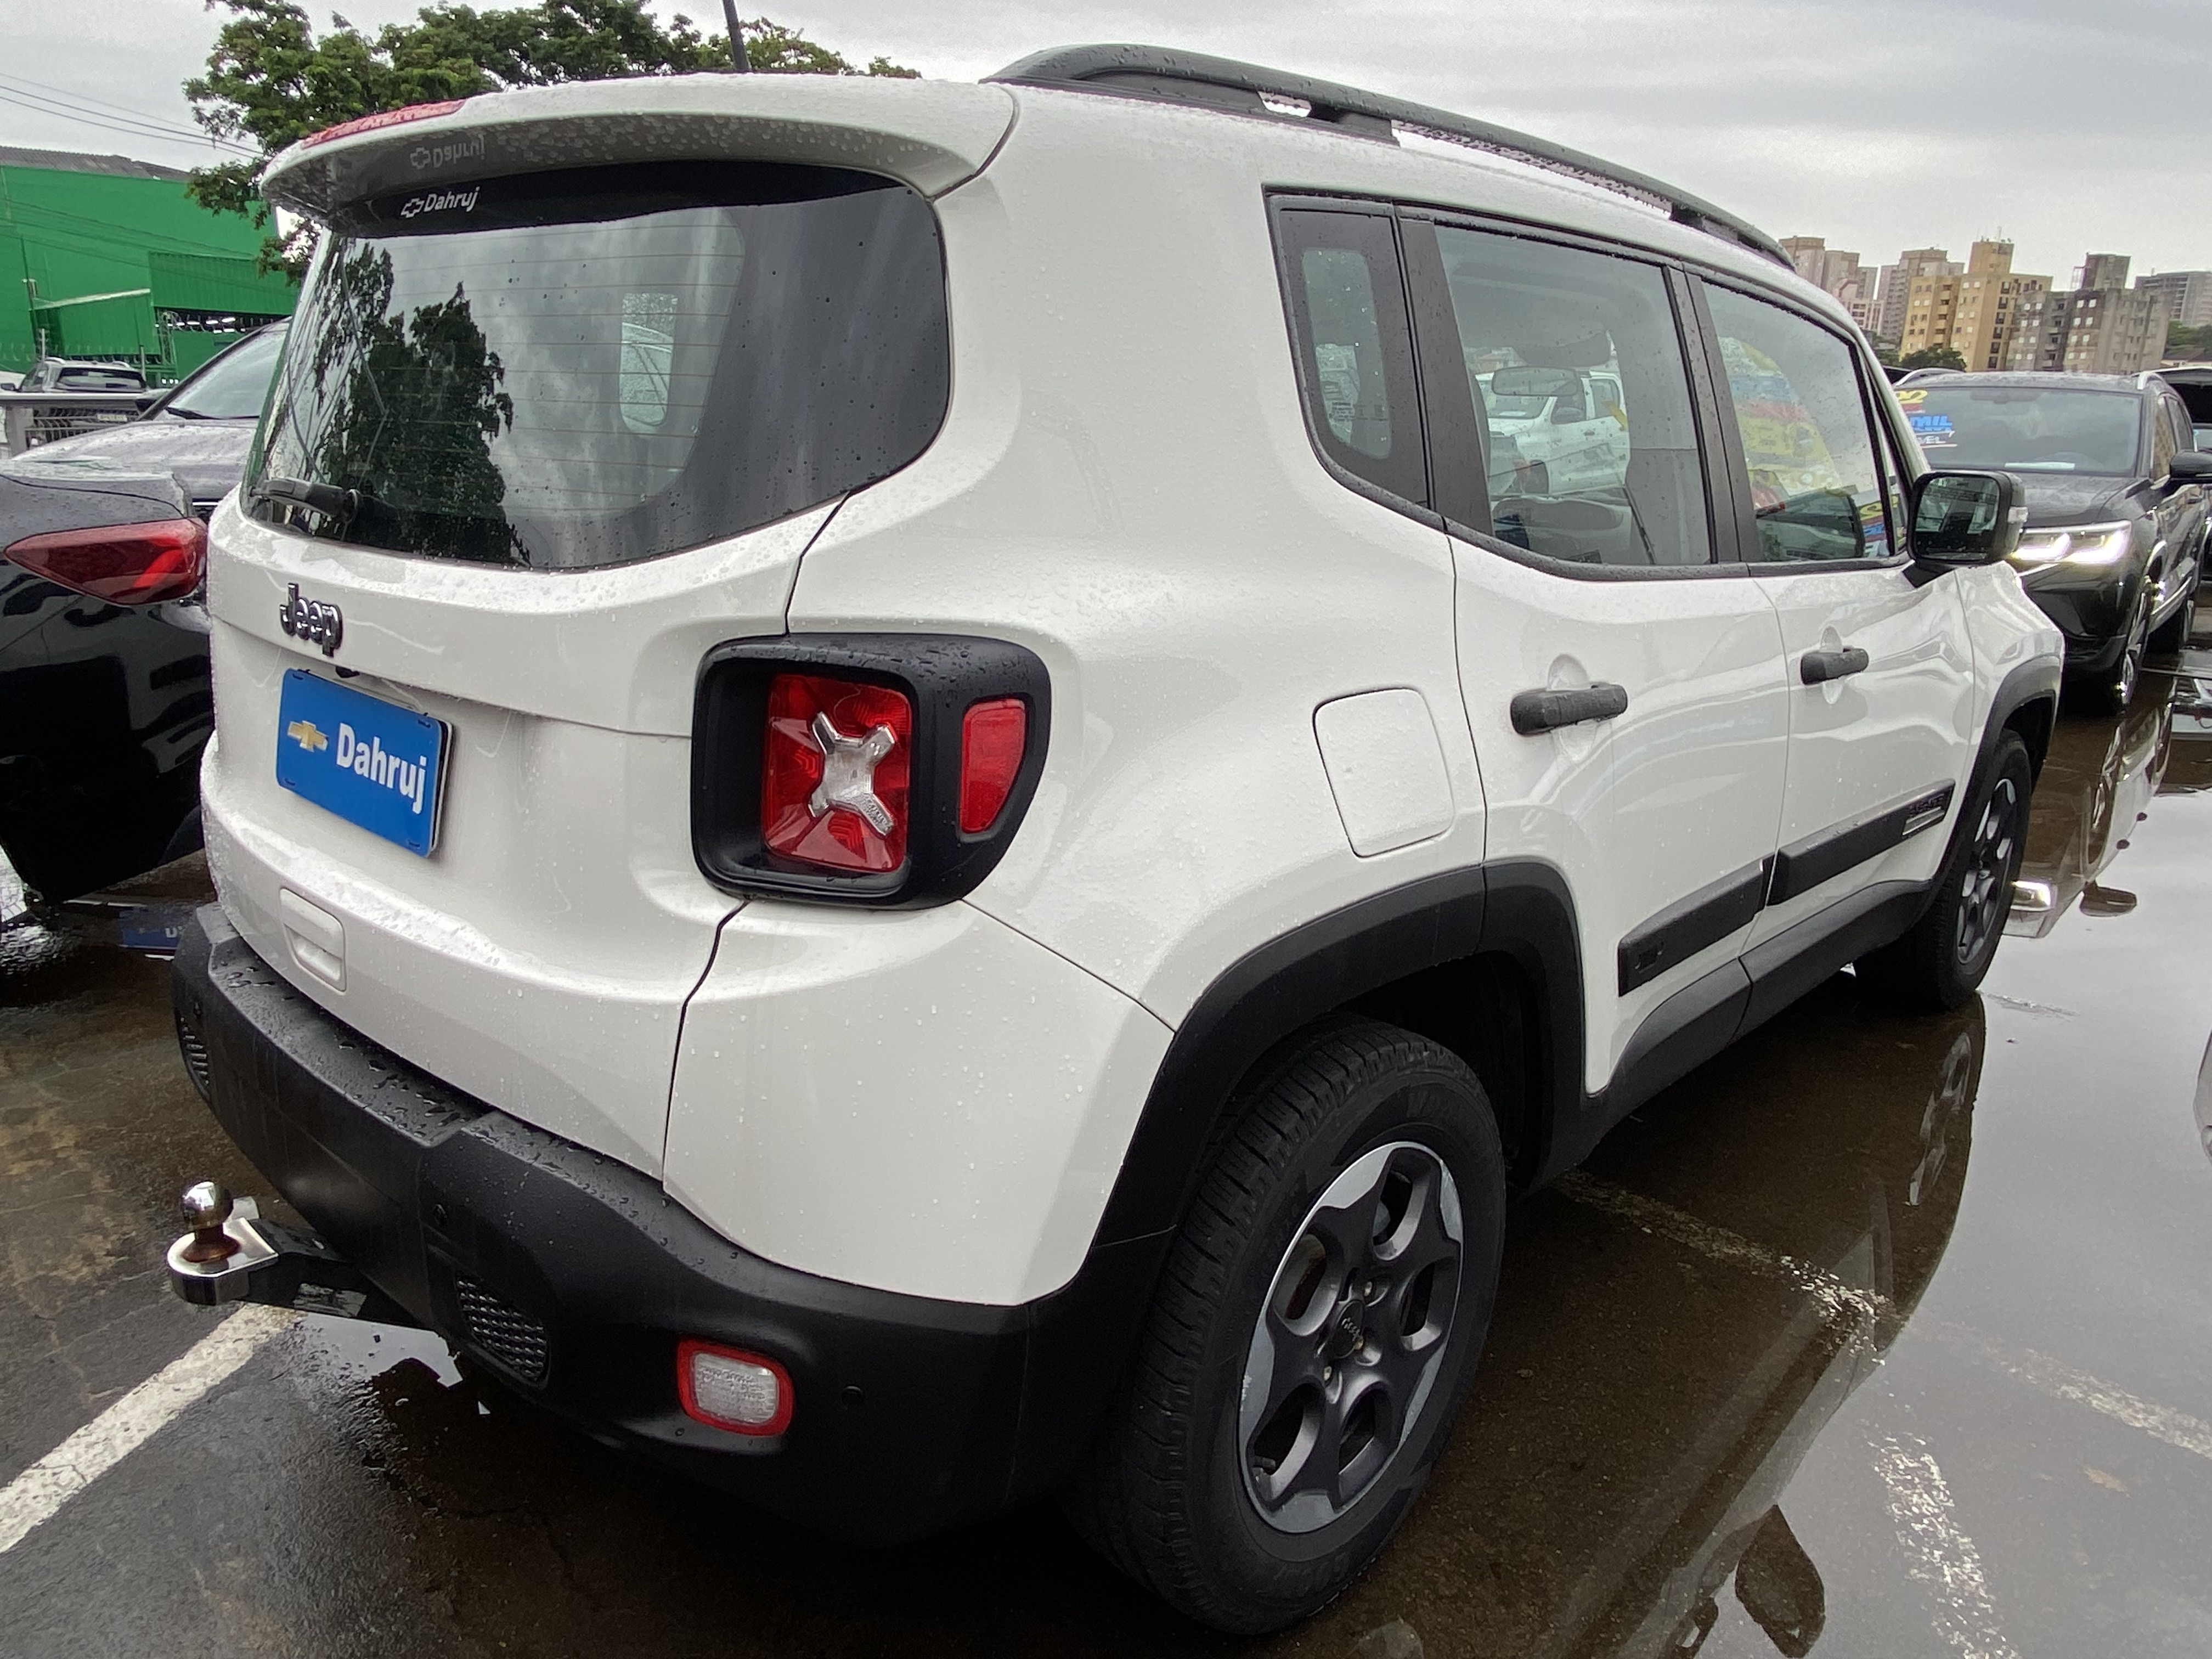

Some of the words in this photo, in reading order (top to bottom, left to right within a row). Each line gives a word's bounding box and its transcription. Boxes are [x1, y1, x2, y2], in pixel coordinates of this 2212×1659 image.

[424, 186, 481, 212] Dahruj
[279, 583, 343, 658] Jeep
[336, 723, 427, 814] Dahruj
